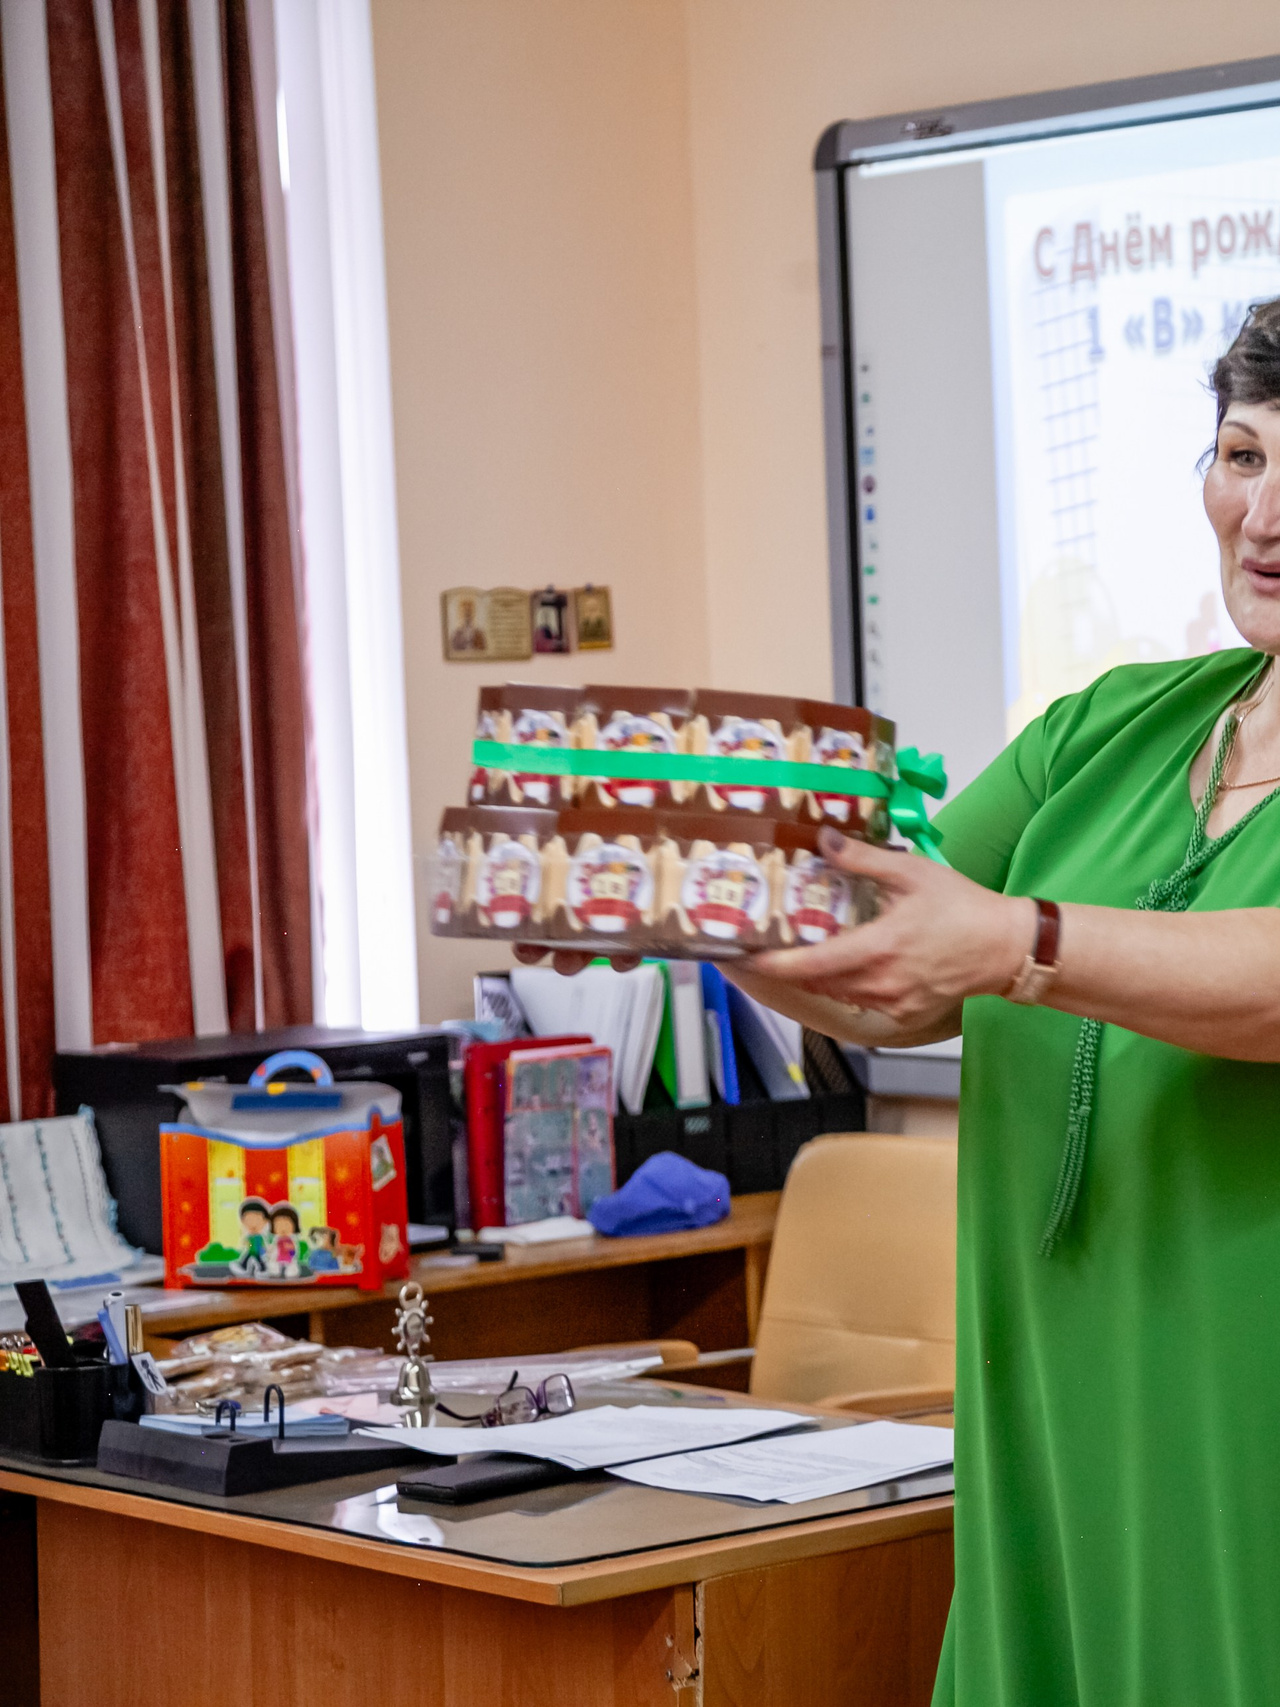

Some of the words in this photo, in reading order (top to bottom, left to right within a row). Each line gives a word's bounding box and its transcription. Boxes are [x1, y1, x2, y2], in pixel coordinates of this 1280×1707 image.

[1033, 227, 1055, 278] С
[1070, 213, 1173, 285] Днём
[1087, 304, 1106, 359] 1
